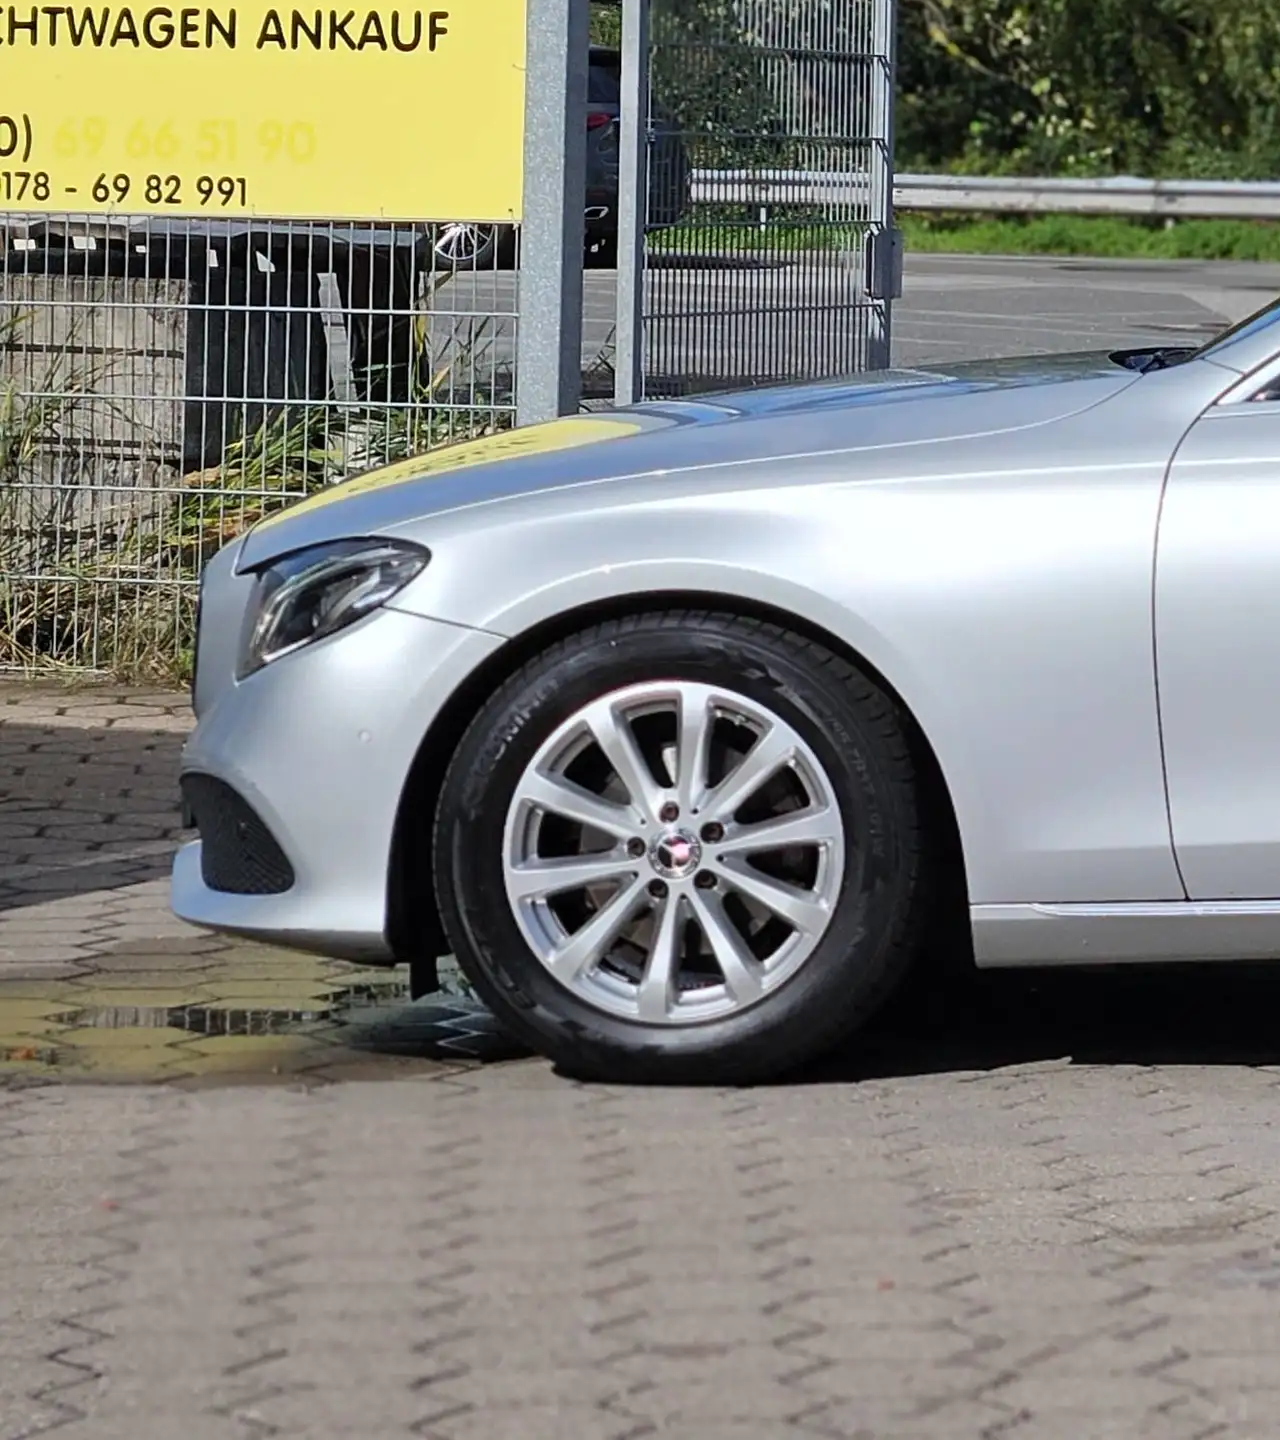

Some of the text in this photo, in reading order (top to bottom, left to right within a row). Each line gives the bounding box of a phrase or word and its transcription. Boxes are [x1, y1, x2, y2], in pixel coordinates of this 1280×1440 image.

[0, 5, 450, 52] HTWAGEN ANKAUF
[0, 171, 51, 202] 178
[91, 172, 131, 203] 69
[144, 174, 182, 205] 82
[196, 175, 247, 207] 991
